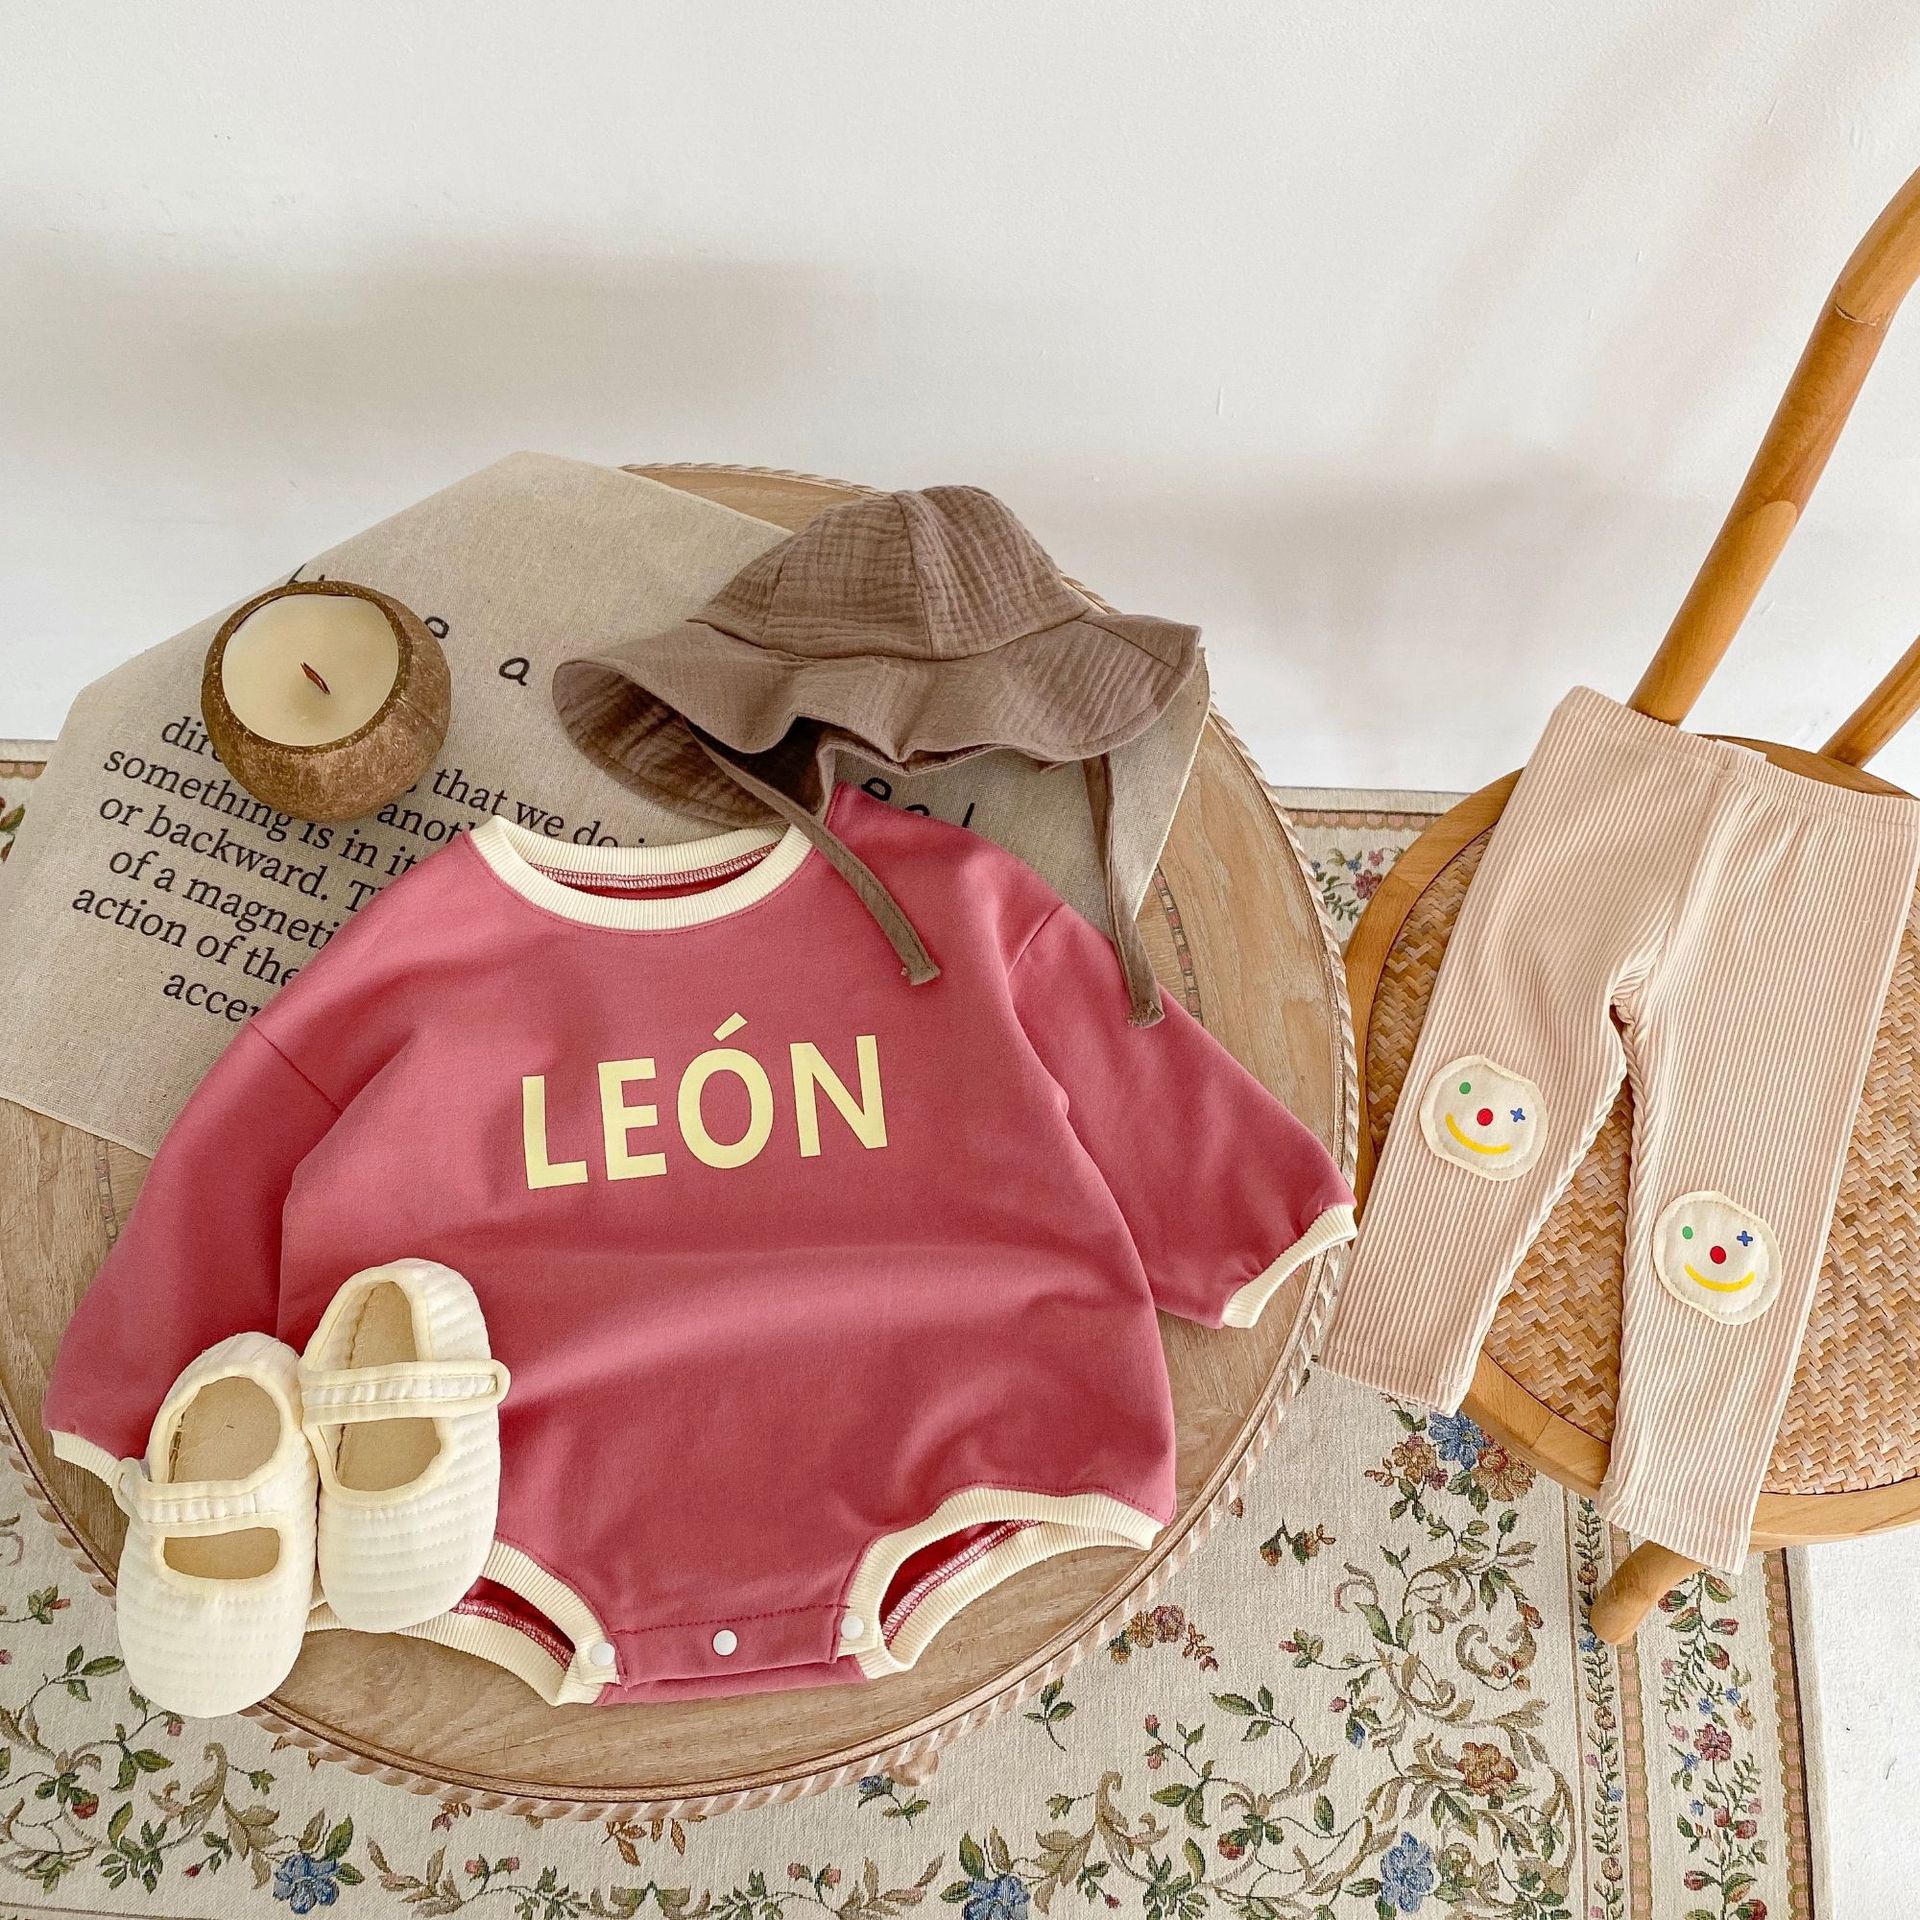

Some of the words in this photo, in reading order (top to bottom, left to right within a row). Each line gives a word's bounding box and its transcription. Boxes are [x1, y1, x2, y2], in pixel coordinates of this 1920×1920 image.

[103, 750, 296, 842] something
[298, 822, 334, 849] is
[338, 828, 378, 868] in
[161, 716, 223, 763] dir
[377, 803, 476, 844] anot
[432, 768, 507, 816] that
[516, 801, 565, 837] we
[100, 798, 143, 827] or
[144, 804, 328, 901] backward.
[109, 850, 159, 880] of
[153, 867, 176, 893] a
[72, 889, 187, 948] action
[196, 935, 246, 965] of
[522, 1012, 888, 1190] LEÓN
